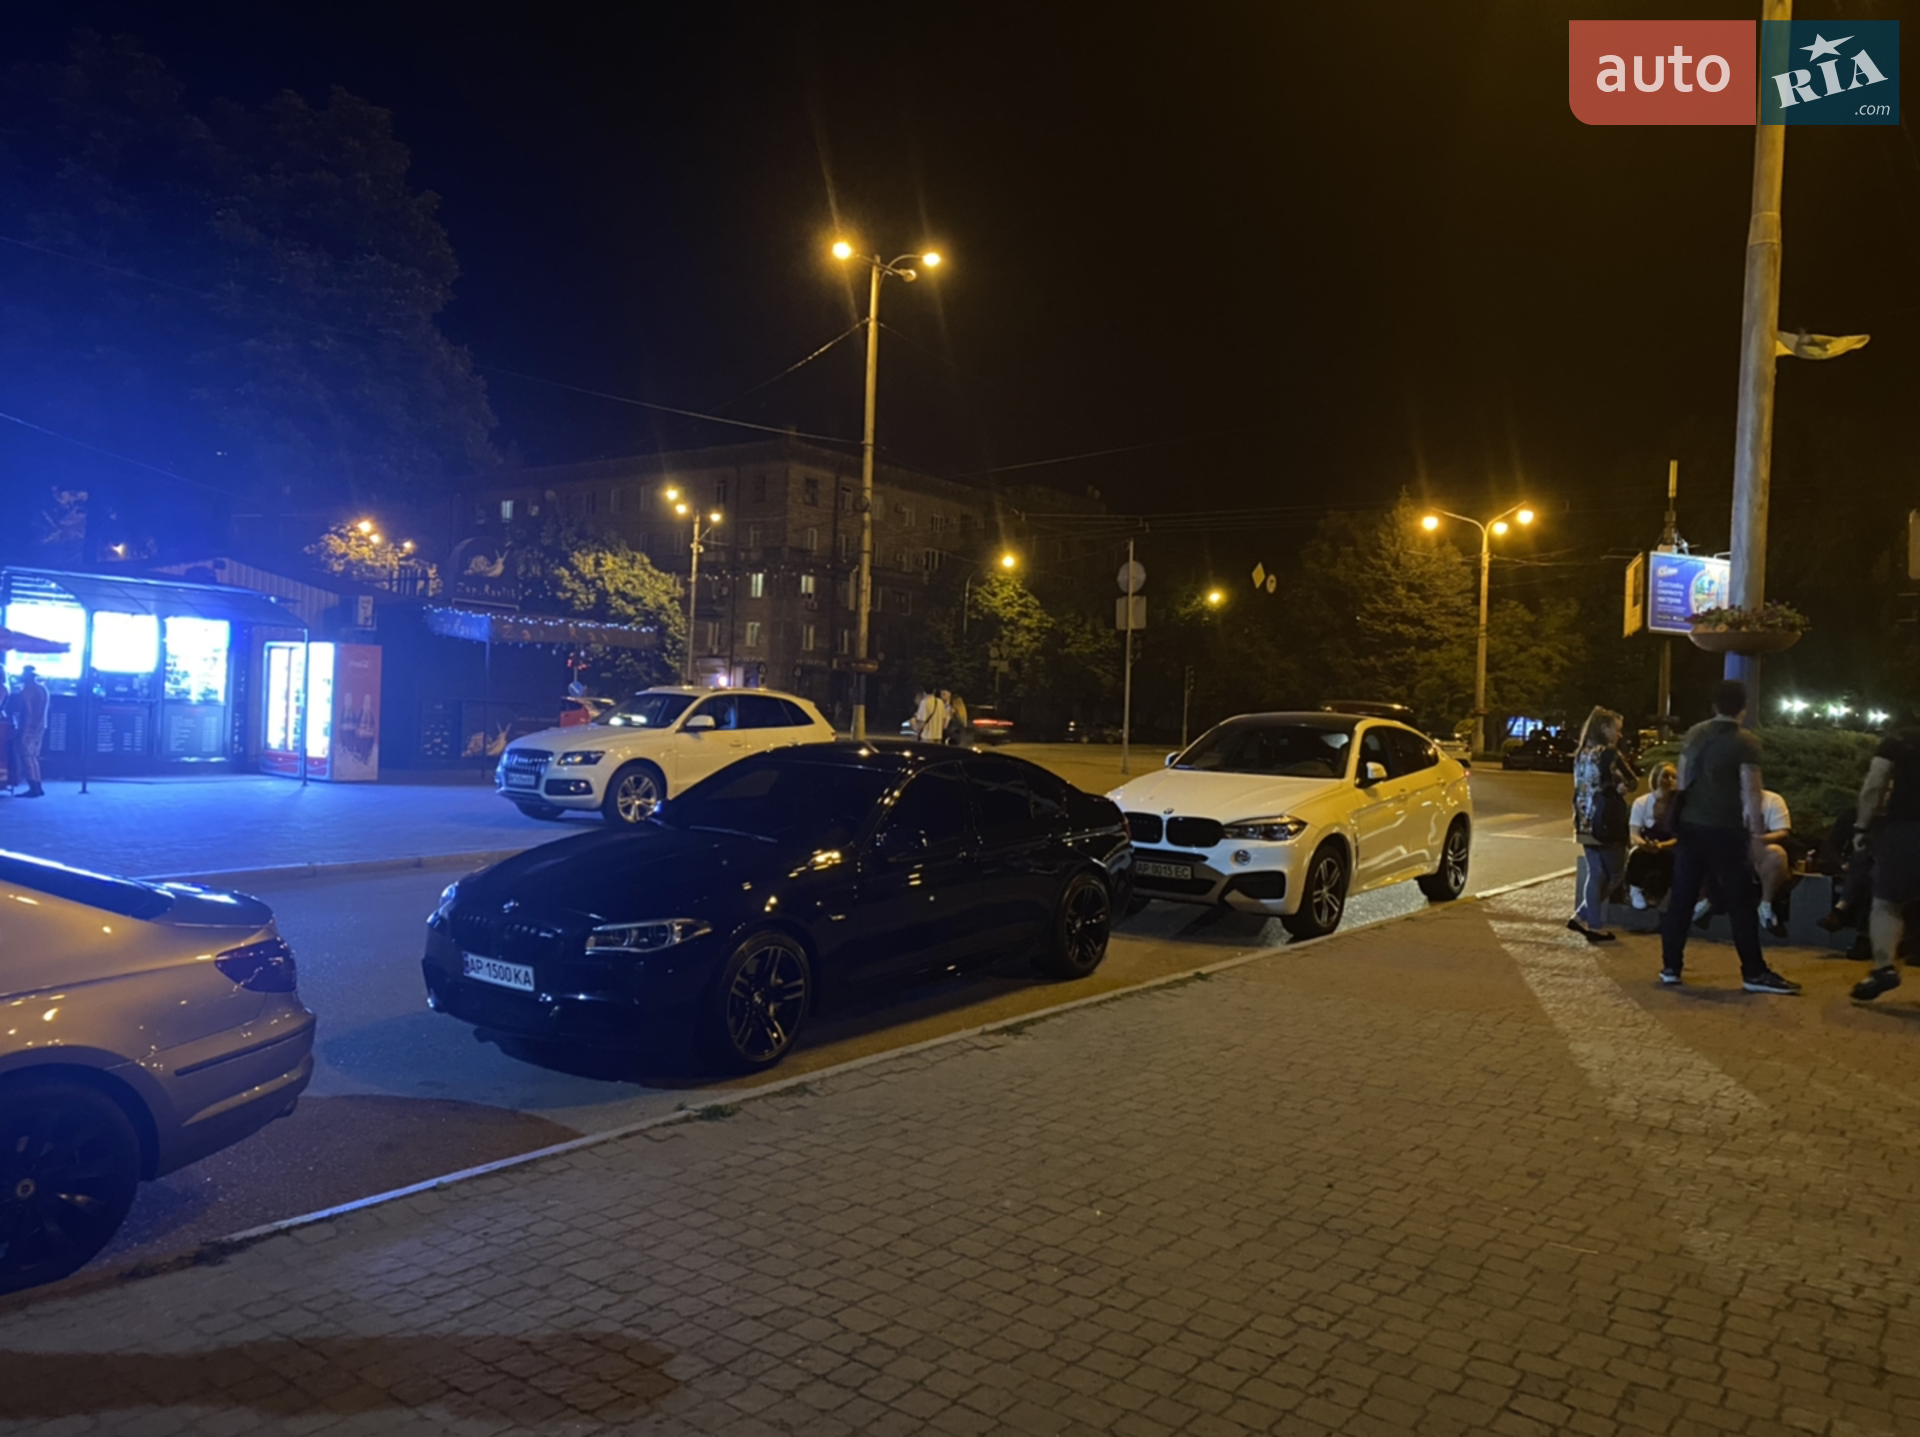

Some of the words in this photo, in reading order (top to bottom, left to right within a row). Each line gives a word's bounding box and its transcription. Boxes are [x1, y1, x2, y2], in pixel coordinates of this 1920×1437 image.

[1174, 866, 1189, 878] EC
[470, 958, 483, 974] AP
[486, 962, 512, 982] 1500
[513, 967, 532, 987] KA
